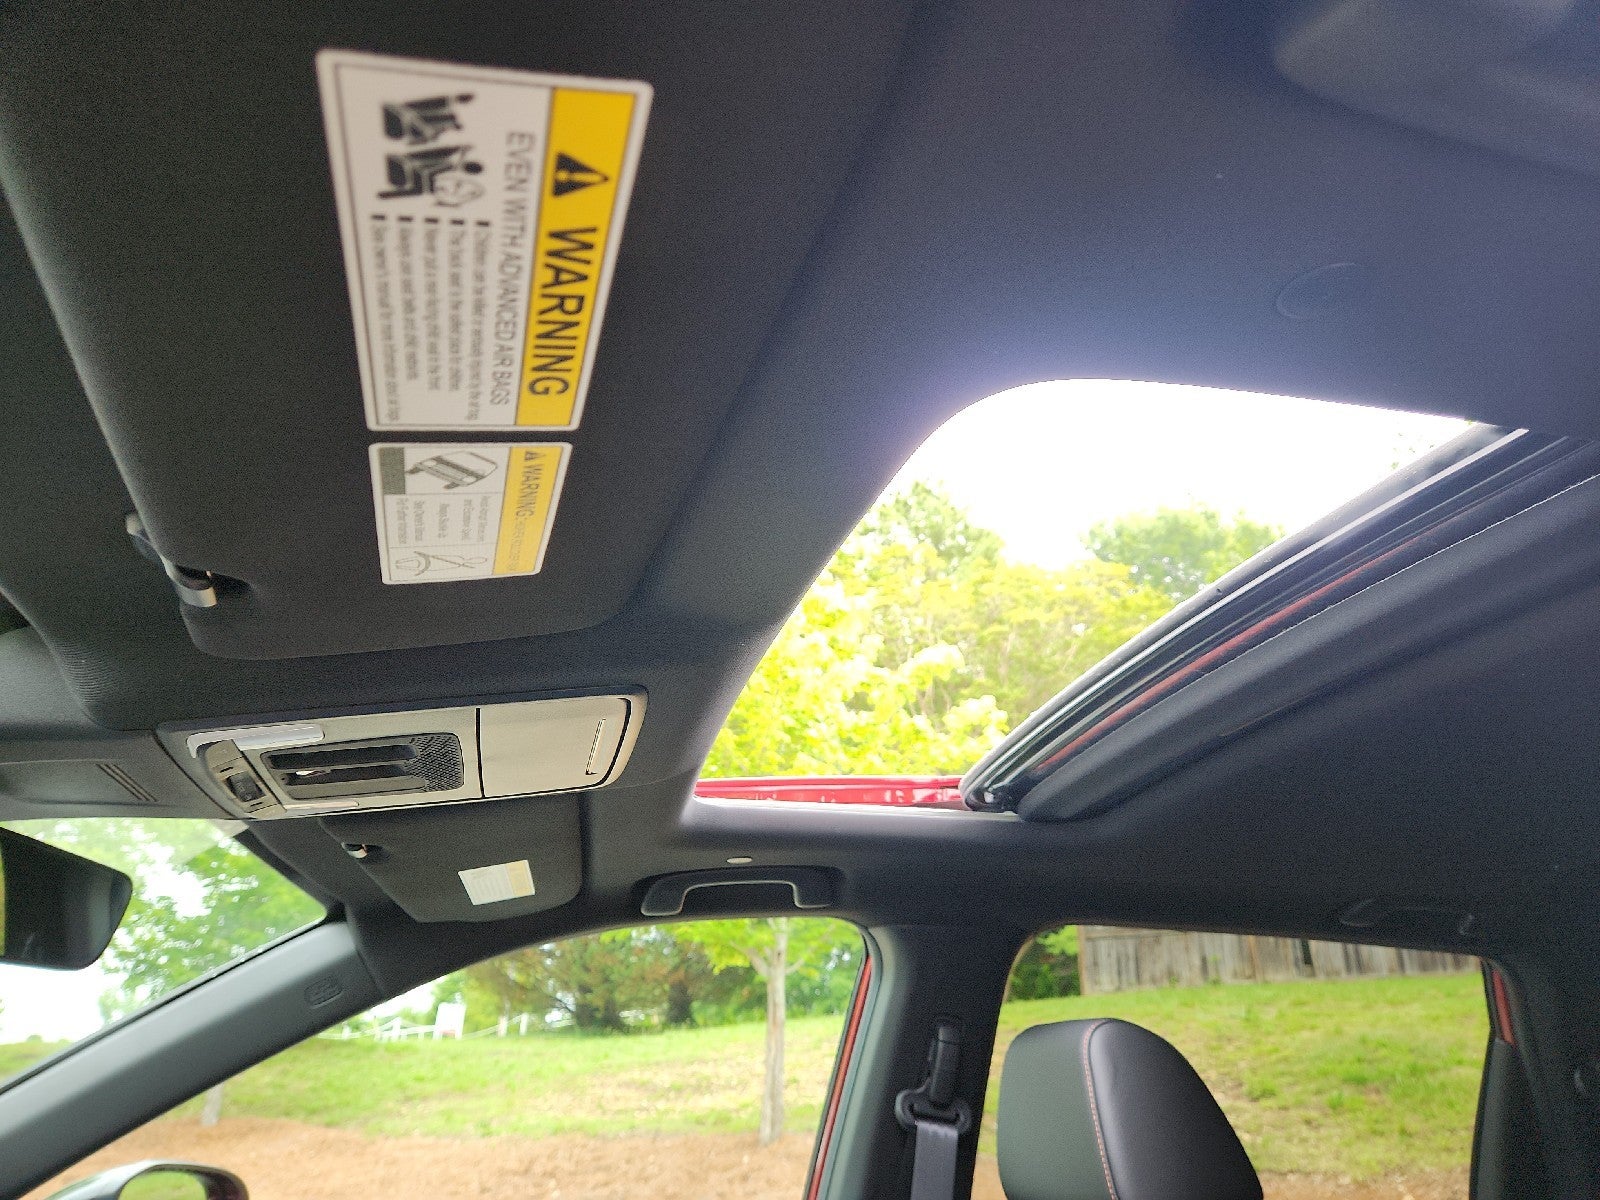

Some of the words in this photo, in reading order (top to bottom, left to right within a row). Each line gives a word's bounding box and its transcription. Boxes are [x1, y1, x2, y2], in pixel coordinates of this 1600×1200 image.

[502, 131, 536, 192] EVEN
[498, 196, 529, 248] WITH
[492, 249, 524, 341] ADVANCED
[527, 224, 598, 395] WARNING
[491, 343, 515, 367] AIR
[488, 370, 513, 405] BAGS
